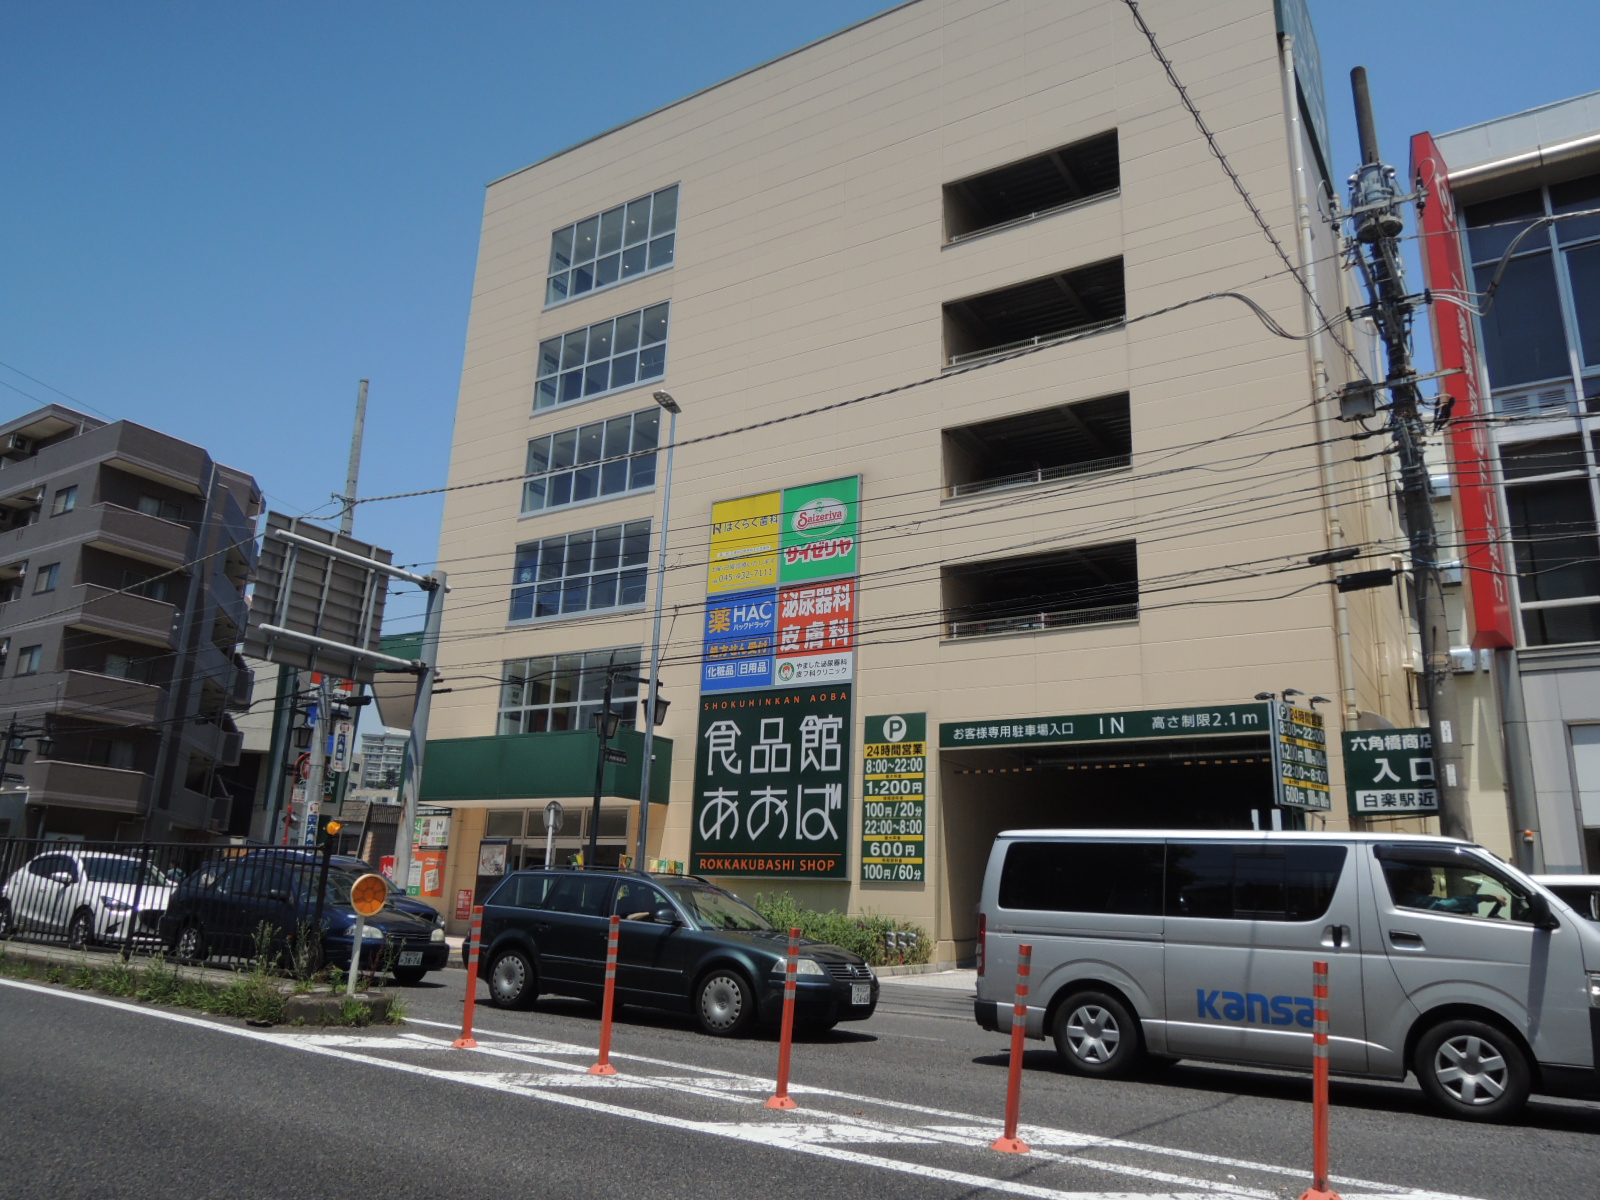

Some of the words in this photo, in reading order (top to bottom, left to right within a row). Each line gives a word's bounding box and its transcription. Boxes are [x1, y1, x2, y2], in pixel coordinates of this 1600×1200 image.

[797, 510, 842, 529] Saizeriya
[785, 538, 852, 564] サイゼリヤ
[782, 584, 850, 618] 泌尿器科
[708, 606, 731, 634] 薬
[733, 601, 772, 623] HAC
[733, 620, 772, 631] ハックドラッグ
[780, 618, 850, 652] 皮膚科
[708, 665, 734, 677] 化粧品
[740, 661, 767, 674] 日用品
[796, 658, 847, 669] やました泌尿器科
[704, 695, 801, 711] SHOKUHINKAN
[809, 691, 847, 703] AOBA
[1099, 716, 1125, 735] IN
[1152, 711, 1259, 730] 高さ制限2.1m
[953, 722, 1074, 741] お客様専用駐車場入口
[704, 714, 843, 776] 食品館
[866, 743, 923, 757] 24時間営業
[1372, 757, 1436, 783] 入口
[865, 780, 922, 795] 1,200円
[864, 801, 923, 817] 100円/20分
[1363, 791, 1435, 808] 白楽駅近
[699, 783, 842, 840] あおば
[870, 842, 916, 857] 600円
[700, 857, 795, 870] ROKKAKUBASHI
[800, 859, 836, 871] SHOP
[863, 864, 922, 880] 100円/60分
